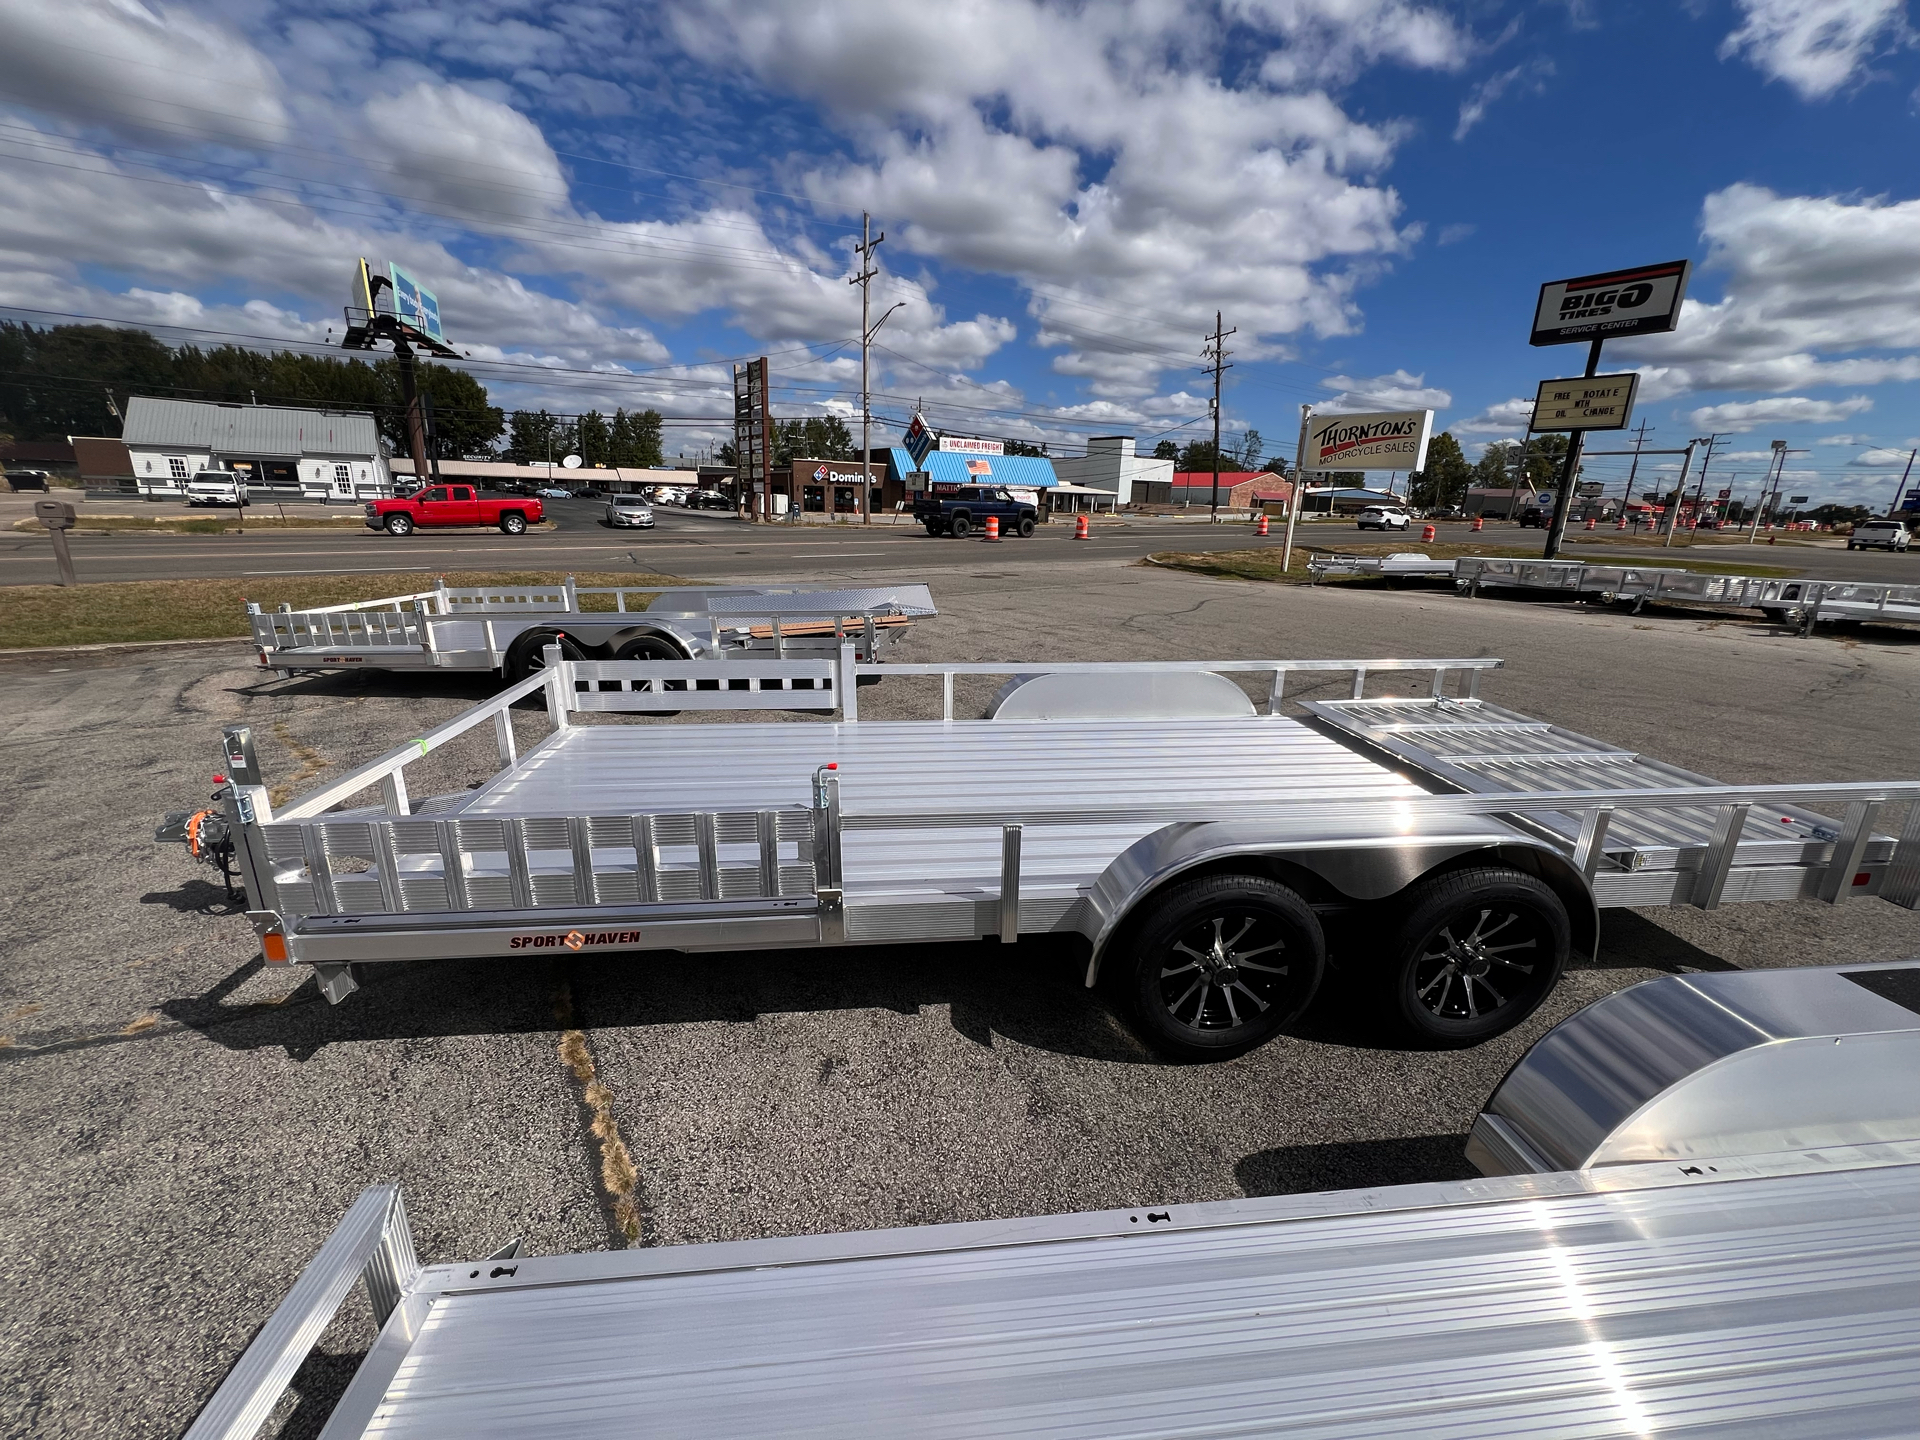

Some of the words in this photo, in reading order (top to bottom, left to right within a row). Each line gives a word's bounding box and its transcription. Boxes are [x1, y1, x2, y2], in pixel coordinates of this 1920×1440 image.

[1559, 305, 1612, 321] TIRES
[1560, 324, 1598, 335] SERVICE
[1601, 319, 1638, 330] CENTER
[1554, 392, 1571, 400] FREE
[1583, 388, 1619, 399] ROTATE
[1555, 410, 1566, 418] OIL
[1583, 407, 1615, 416] CHANGE
[1313, 418, 1417, 450] THORNTON'S
[949, 439, 980, 450] UNCLAIMED
[981, 442, 1002, 451] FREIGHT
[1318, 445, 1382, 466] MOTORCYCLE
[1384, 442, 1416, 453] SALES
[829, 471, 877, 483] Domin's
[510, 935, 567, 949] SPORT
[584, 931, 640, 945] HAVEN
